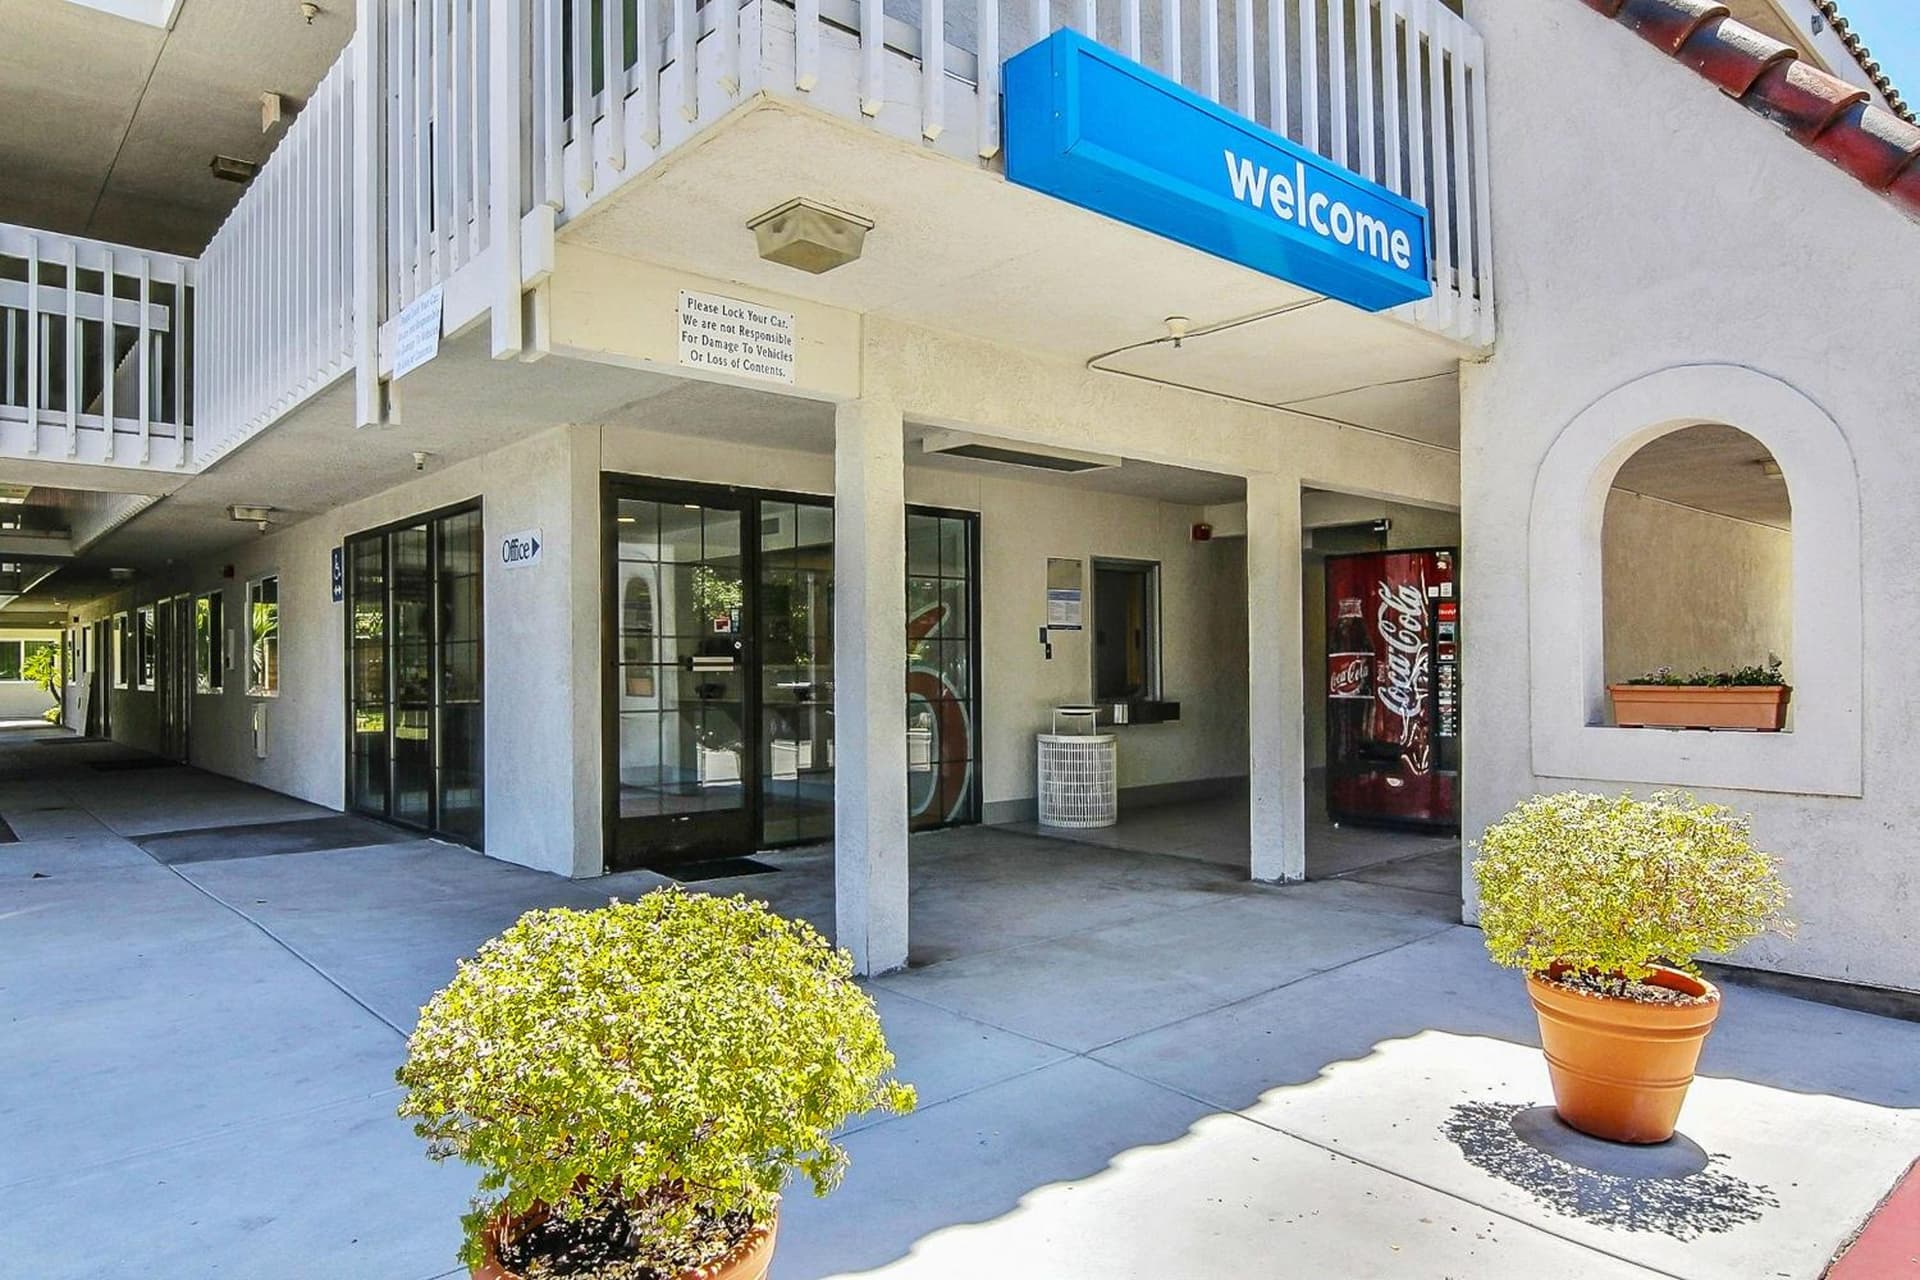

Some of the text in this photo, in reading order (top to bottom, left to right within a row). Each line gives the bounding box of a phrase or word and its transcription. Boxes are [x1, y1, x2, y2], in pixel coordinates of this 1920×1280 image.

[1224, 149, 1410, 270] welcome
[687, 297, 789, 329] Please Lock Your Car.
[682, 313, 792, 346] We are not Responsible
[681, 331, 793, 362] For Damage To Vehicles
[690, 350, 786, 377] Or Loss of Contents.
[502, 538, 530, 563] Office
